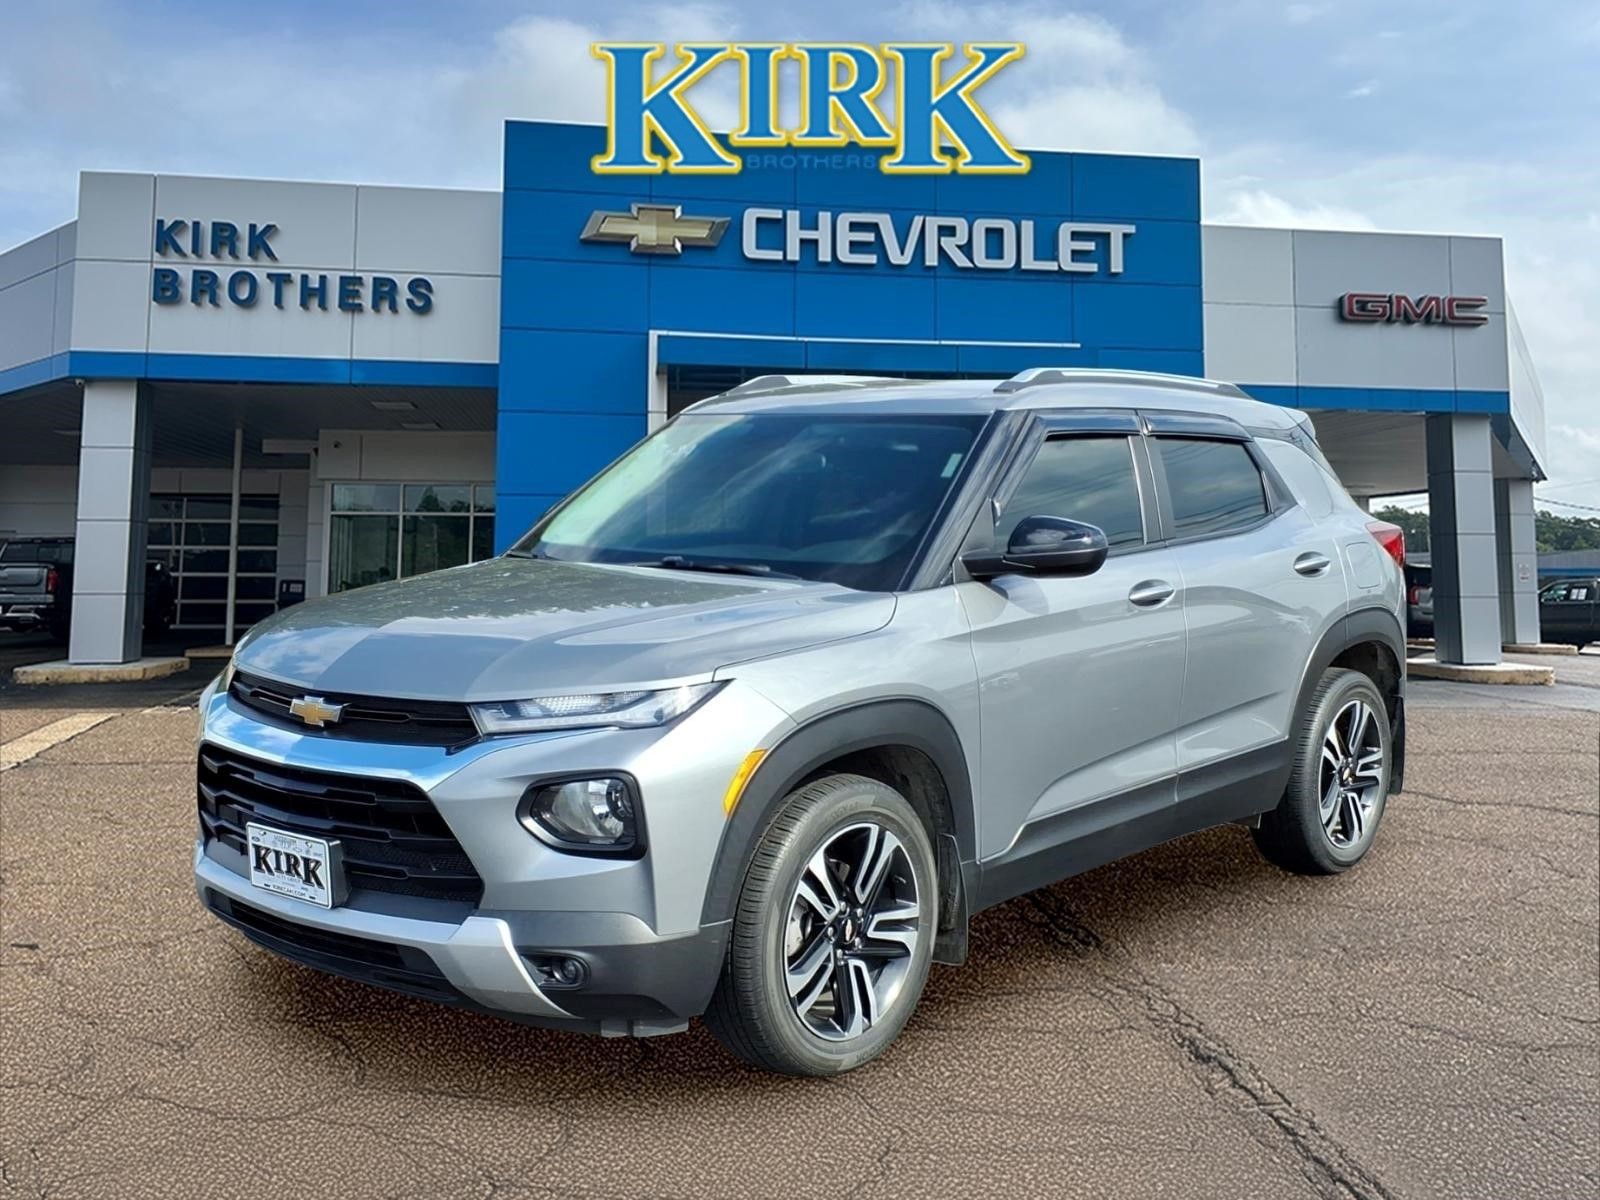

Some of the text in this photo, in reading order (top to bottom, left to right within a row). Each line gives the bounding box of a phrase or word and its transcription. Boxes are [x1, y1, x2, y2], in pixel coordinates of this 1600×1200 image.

[155, 218, 279, 261] KIRK
[742, 207, 1137, 274] CHEVROLET
[152, 267, 434, 315] BROTHERS
[1339, 291, 1489, 327] GMC
[251, 843, 325, 890] KIRK
